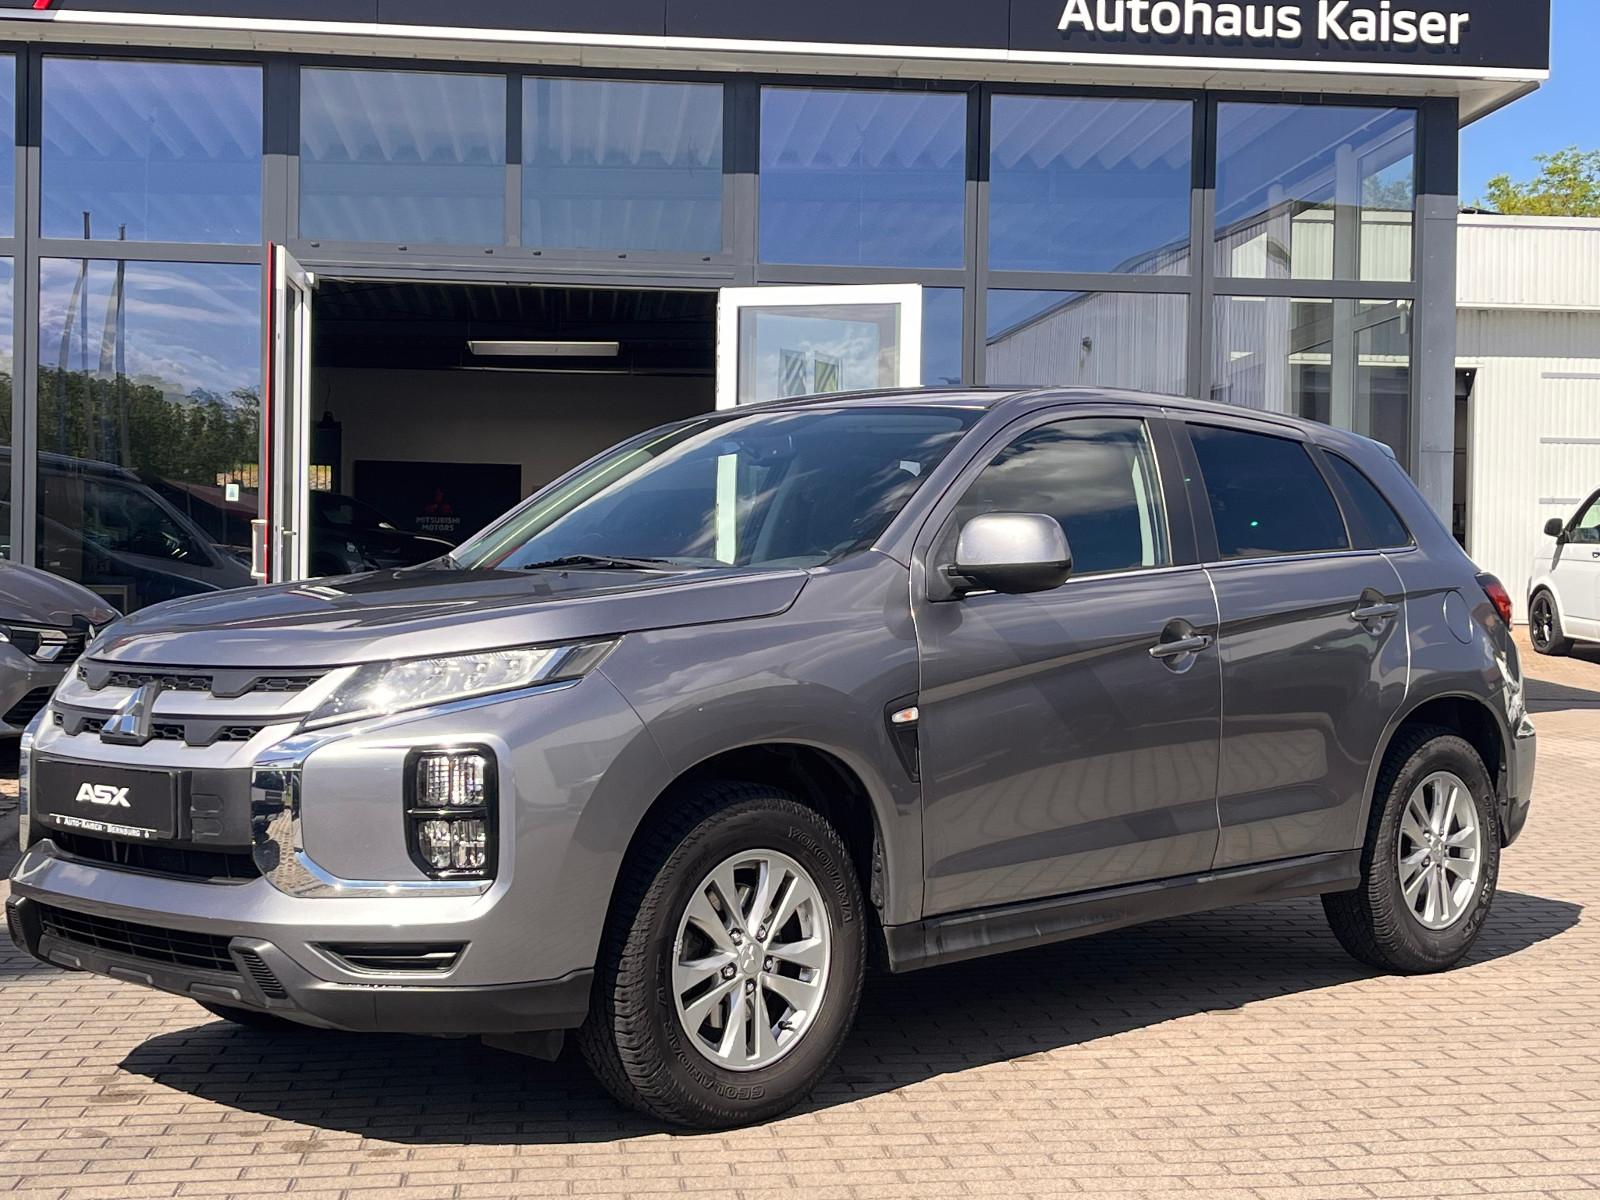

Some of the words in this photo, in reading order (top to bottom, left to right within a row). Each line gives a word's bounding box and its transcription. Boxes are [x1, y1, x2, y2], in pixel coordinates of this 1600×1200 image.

[1058, 0, 1301, 38] Autohaus
[1318, 0, 1469, 45] Kaiser
[416, 516, 460, 524] MITSUBISHI
[76, 782, 131, 808] ASX
[787, 825, 853, 924] YOKOHAMA
[663, 1020, 766, 1101] GEOLANDAR
